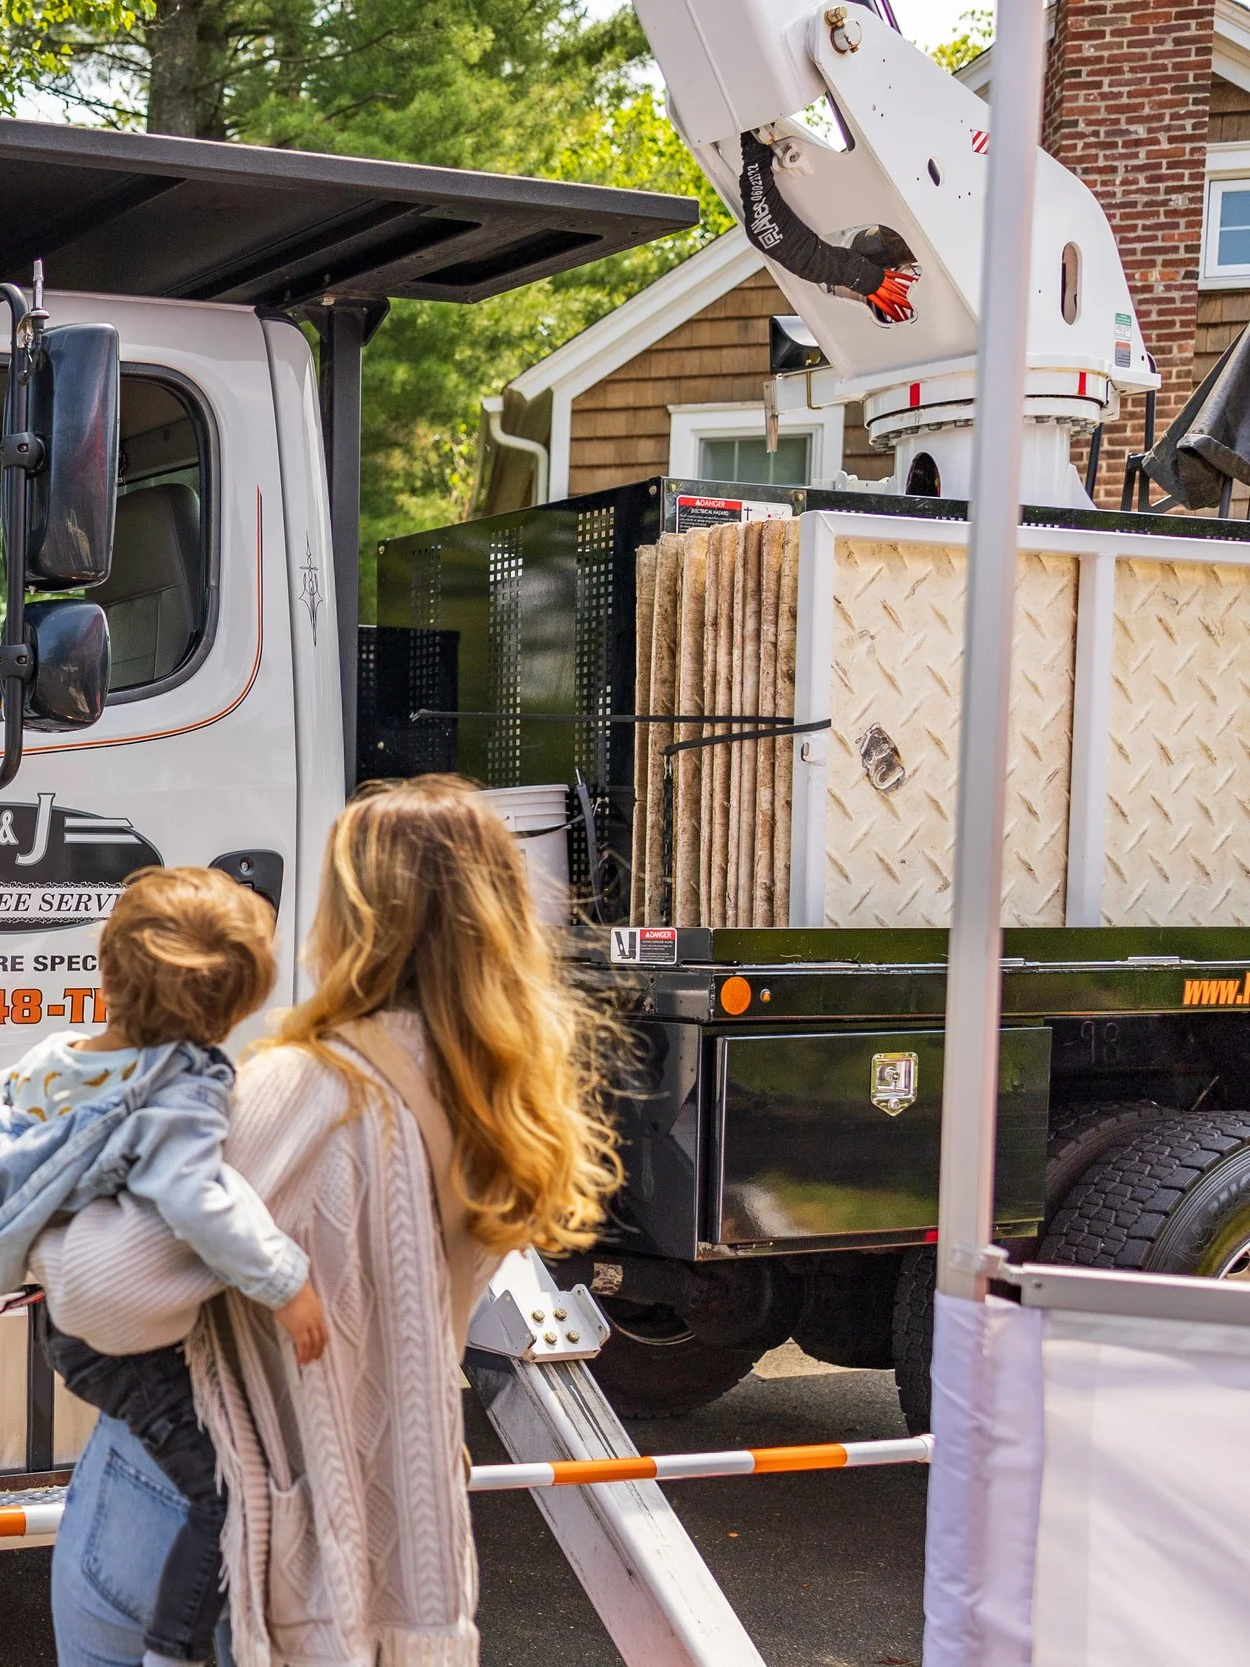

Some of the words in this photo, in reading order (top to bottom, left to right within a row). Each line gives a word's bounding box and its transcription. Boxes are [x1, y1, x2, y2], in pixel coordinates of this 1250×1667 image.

[700, 499, 726, 508] DANGER
[15, 792, 56, 866] J
[649, 931, 672, 939] DANGER
